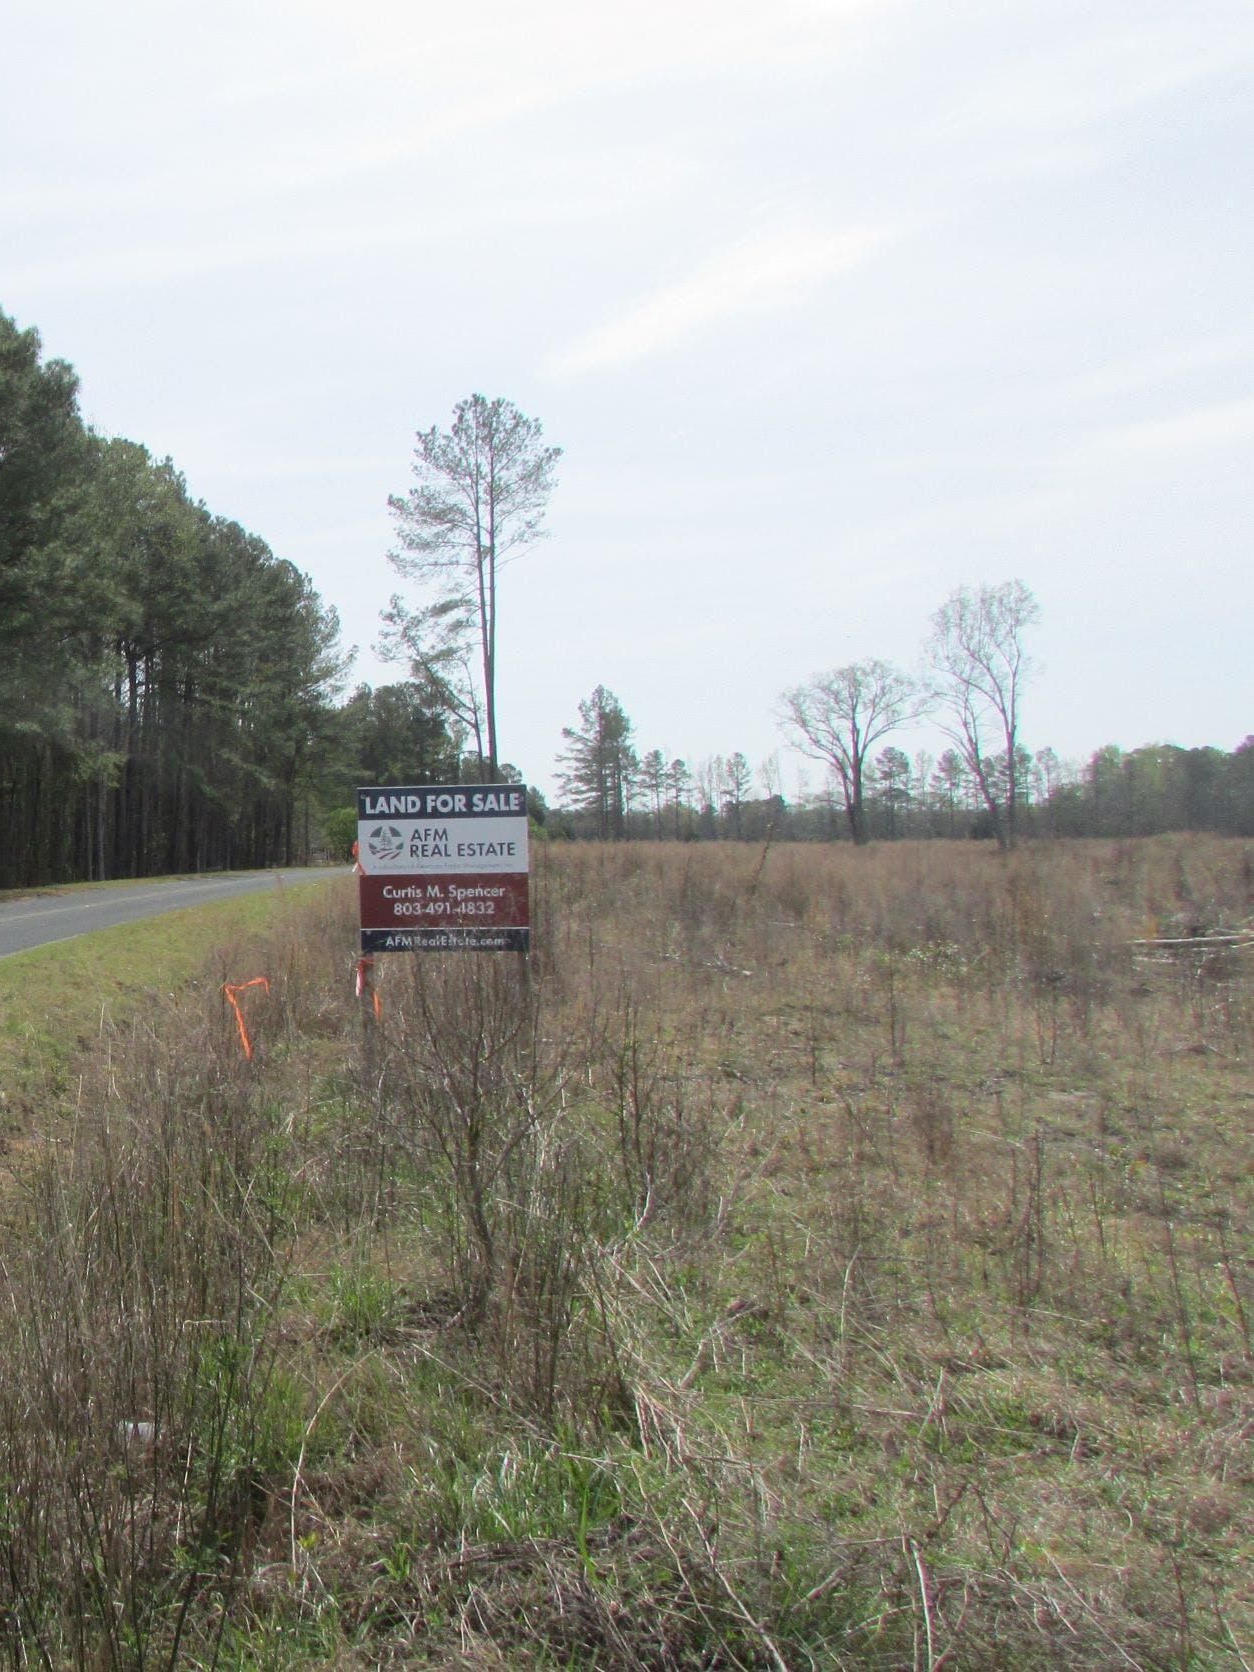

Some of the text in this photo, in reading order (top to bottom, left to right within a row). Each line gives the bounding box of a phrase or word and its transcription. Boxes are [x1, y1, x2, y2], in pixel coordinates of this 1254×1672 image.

[365, 793, 520, 814] LAND FOR SALE
[410, 828, 449, 842] AFM
[410, 842, 515, 858] REAL ESTATE
[383, 884, 506, 900] Curtis M. Spencer
[393, 902, 495, 916] 803-491-4832
